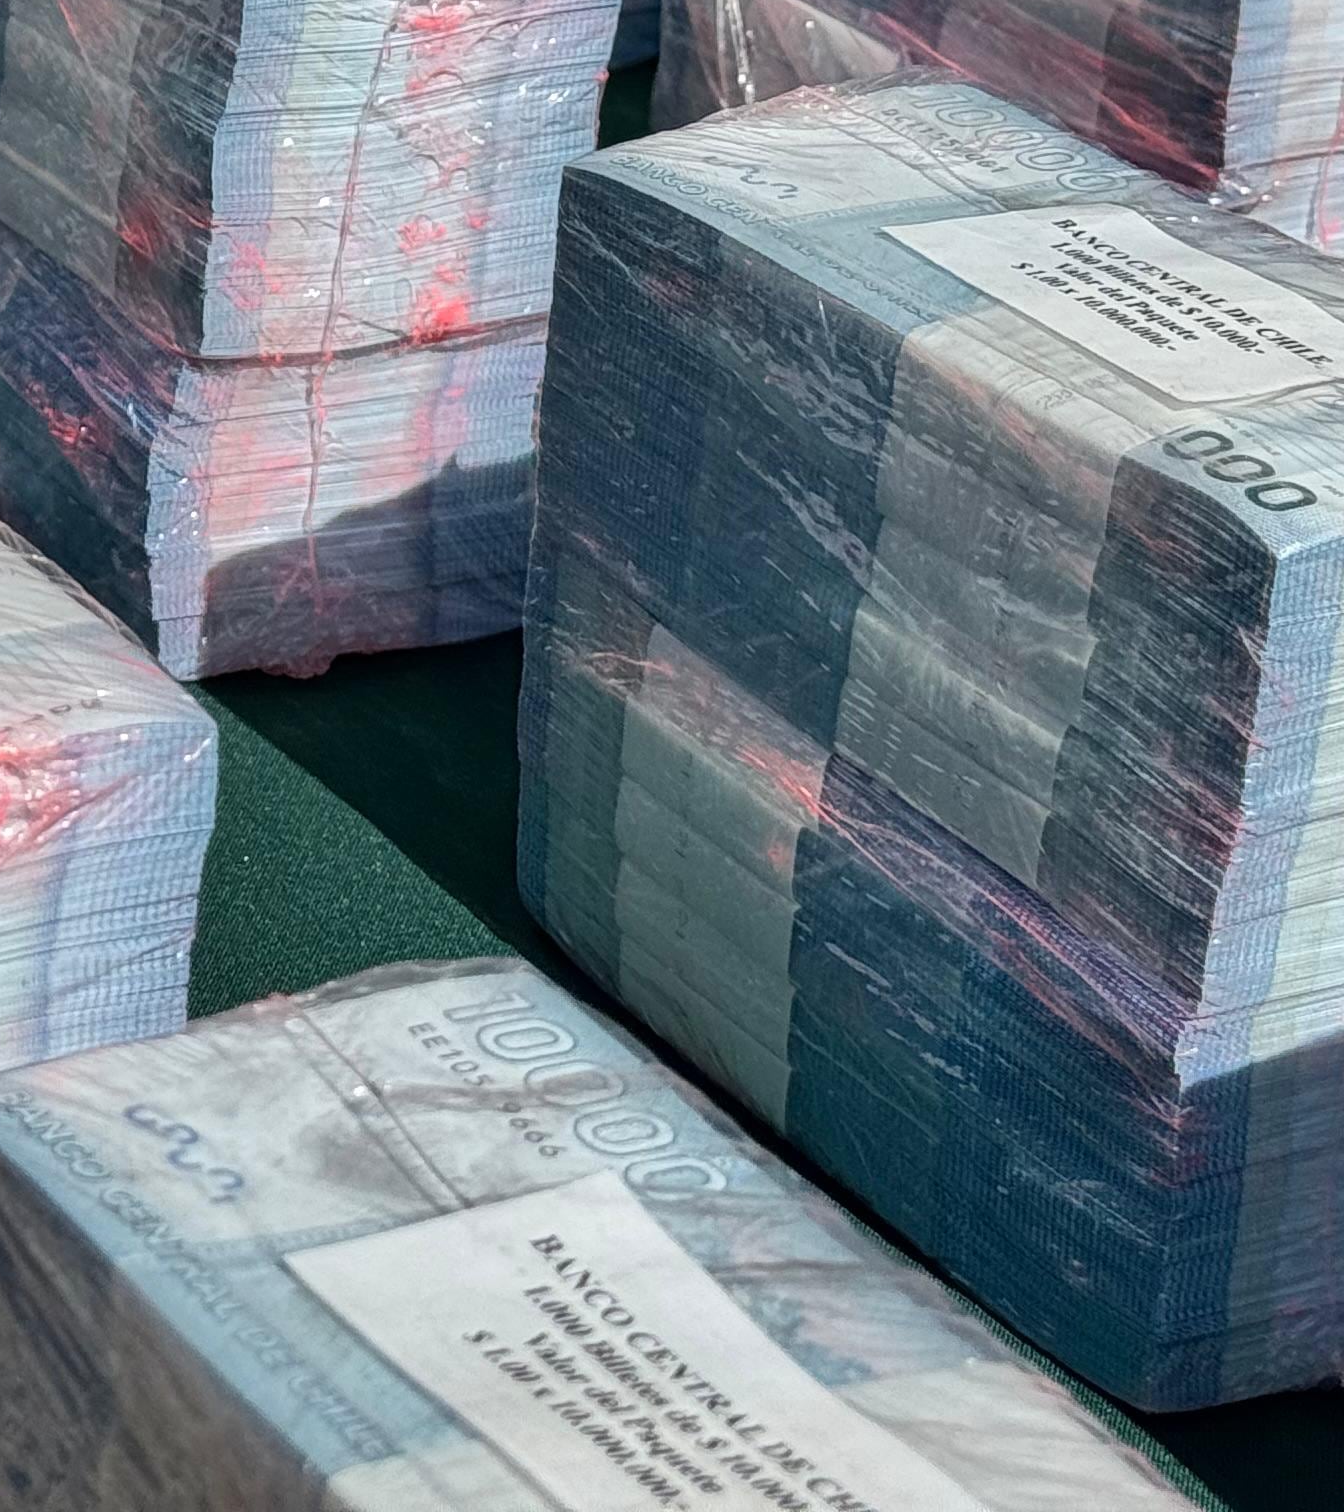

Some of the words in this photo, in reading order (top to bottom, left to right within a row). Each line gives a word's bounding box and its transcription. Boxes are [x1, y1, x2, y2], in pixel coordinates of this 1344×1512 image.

[1010, 262, 1034, 270] $
[1025, 270, 1070, 287] 1.00
[1074, 295, 1177, 352] 10.000.000.-
[1050, 242, 1103, 266] 1.000
[1094, 264, 1161, 295] Billetes
[1155, 295, 1184, 308] de
[1179, 307, 1203, 316] $
[1193, 316, 1266, 354] 10.000.-
[1051, 219, 1130, 260] BANCO
[1125, 260, 1228, 309] CENTRAL
[1221, 307, 1264, 327] DE
[1255, 327, 1334, 369] CHILE
[1055, 263, 1105, 286] Valor
[1097, 287, 1137, 302] del
[1125, 301, 1201, 341] Paquete
[1163, 429, 1318, 512] 000
[408, 1021, 561, 1162] EE1059666
[443, 991, 728, 1202] 10000
[482, 1347, 543, 1383] 1.00
[523, 1332, 591, 1385] Valor
[582, 1387, 637, 1414] del
[622, 1417, 724, 1494] Paquete
[524, 1286, 594, 1337] 1.000
[581, 1340, 670, 1406] Billetes
[663, 1410, 703, 1434] de
[529, 1234, 635, 1326] BANCO
[625, 1331, 767, 1444] CENTRAL
[760, 1441, 817, 1474] DE
